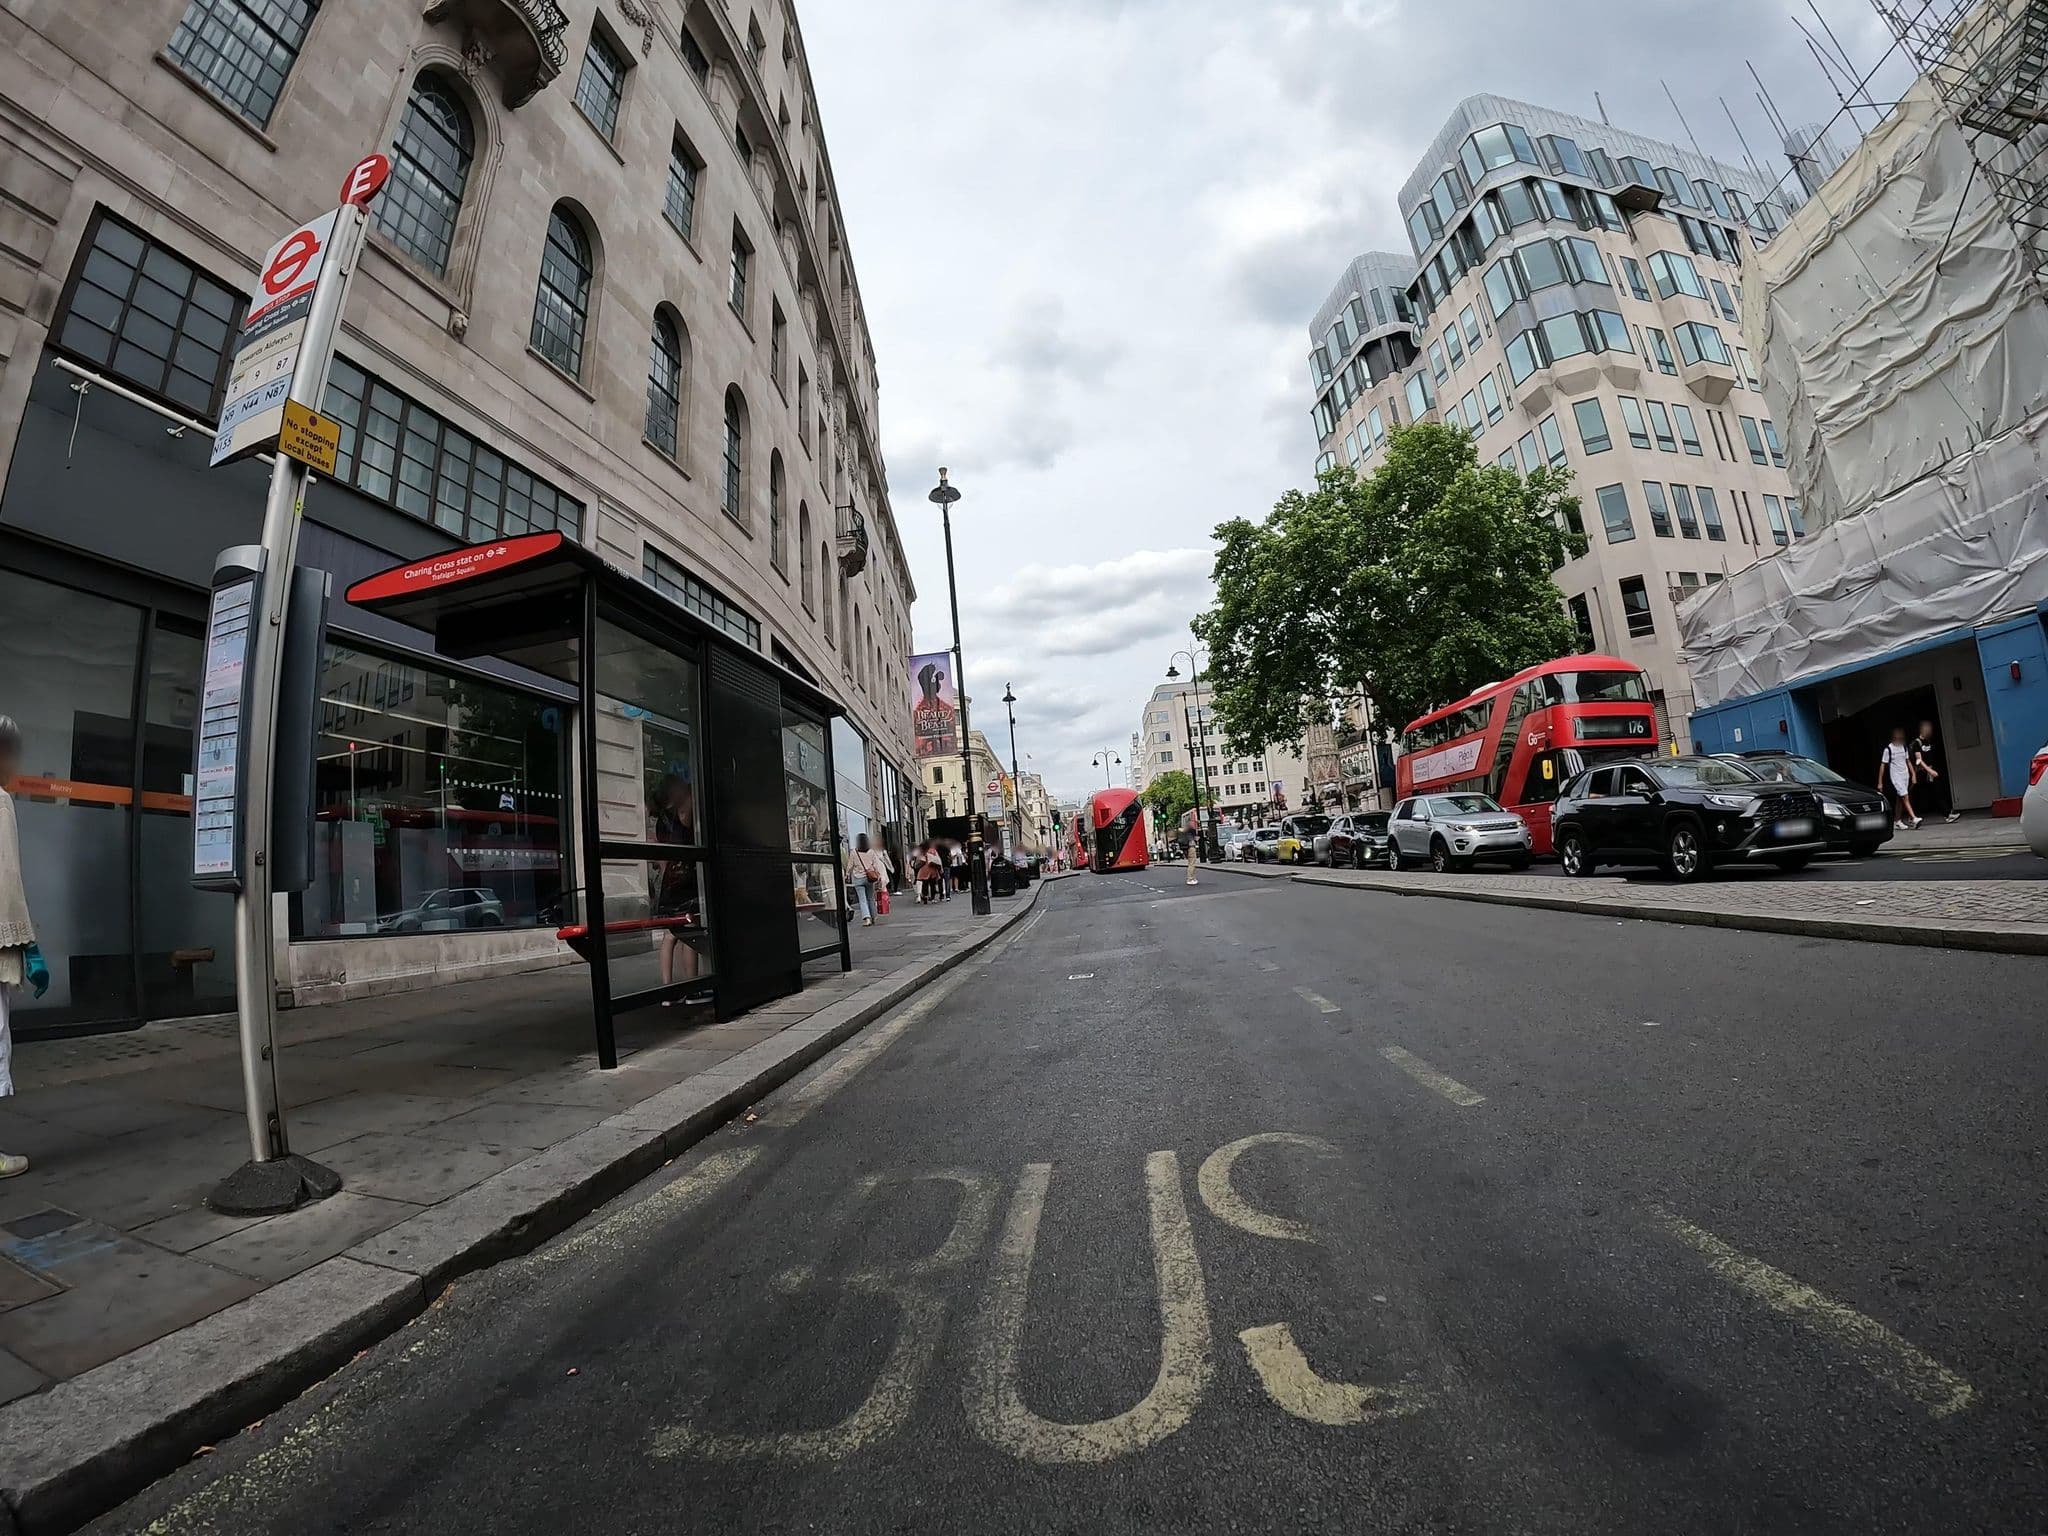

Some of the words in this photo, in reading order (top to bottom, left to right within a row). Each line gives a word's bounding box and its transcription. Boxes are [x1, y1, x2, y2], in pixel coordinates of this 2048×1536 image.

[350, 158, 377, 196] E
[264, 310, 280, 323] Cross
[240, 346, 263, 366] towards
[264, 332, 293, 350] Aldwych
[276, 357, 289, 371] 87
[255, 370, 261, 381] 9
[265, 384, 286, 402] N87
[241, 397, 260, 414] N44
[223, 410, 235, 425] N9
[286, 417, 299, 431] No
[300, 427, 335, 451] stopping
[212, 435, 233, 457] N155
[284, 440, 305, 457] local
[306, 450, 330, 469] buses
[295, 436, 323, 455] except
[404, 566, 433, 580] Charing
[433, 559, 456, 572] Cross
[1628, 720, 1644, 735] 176
